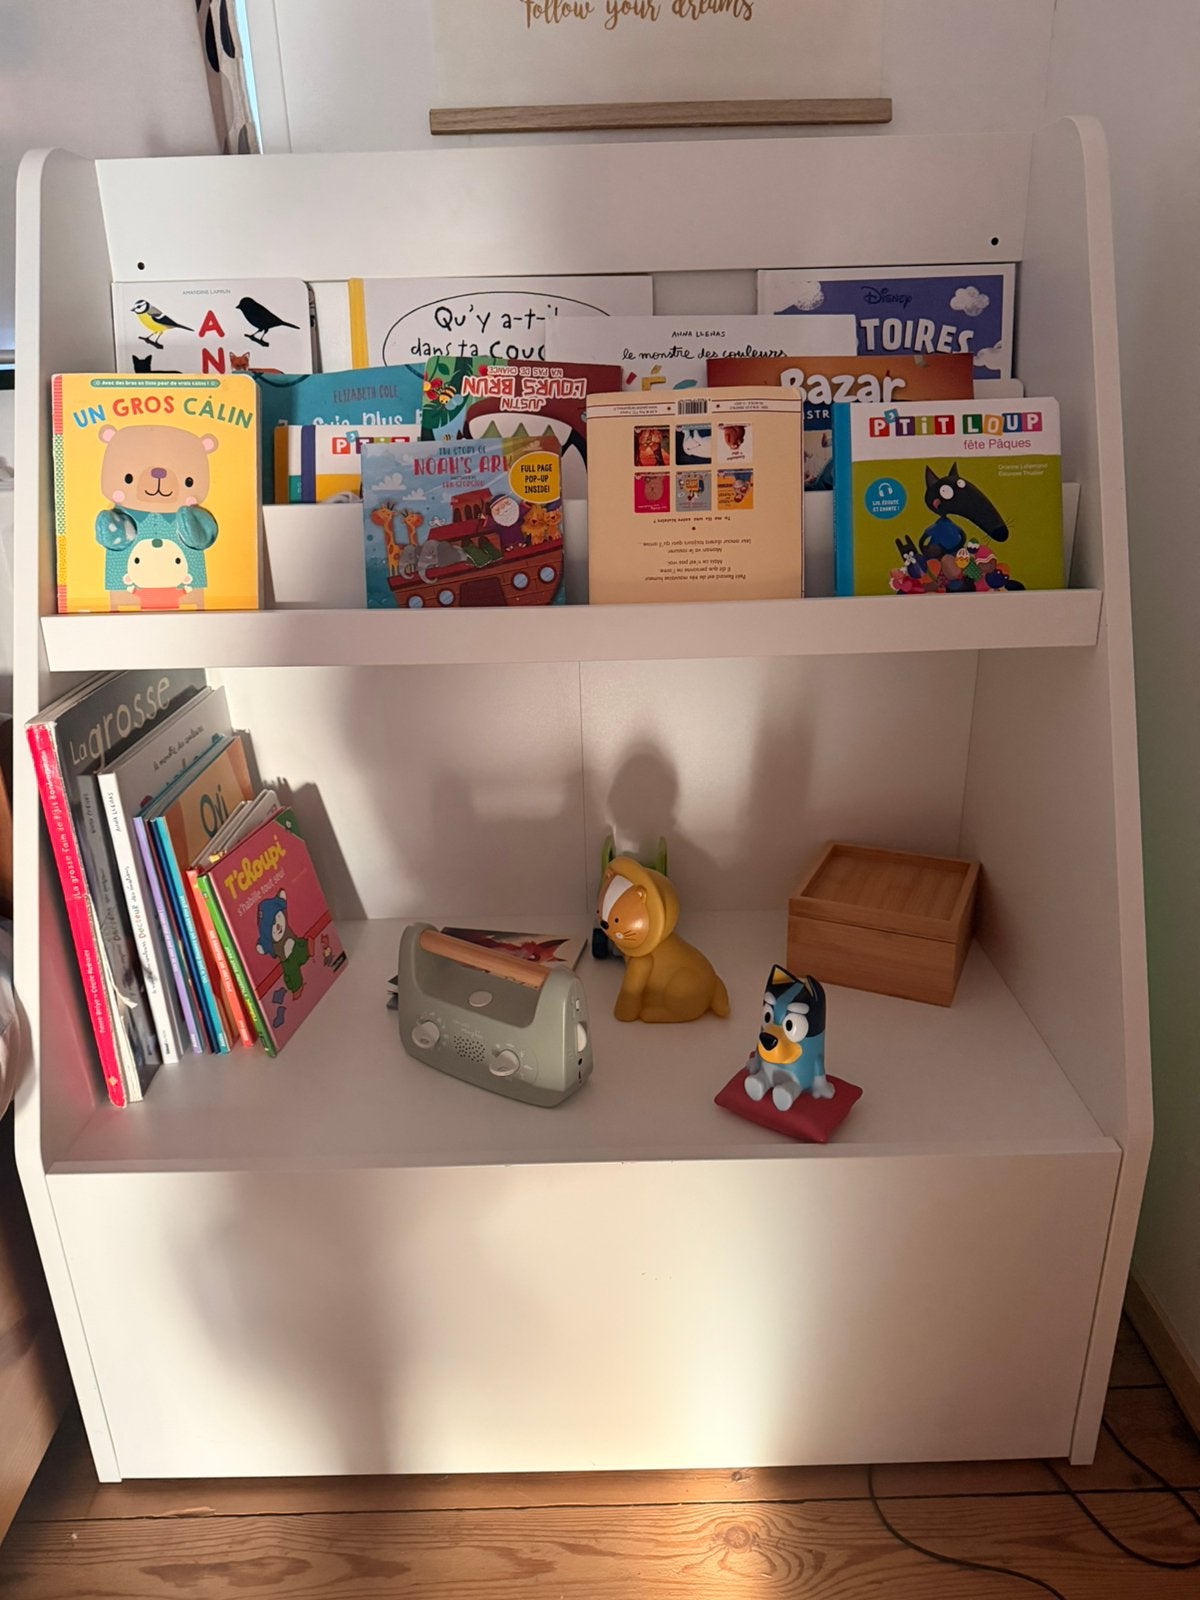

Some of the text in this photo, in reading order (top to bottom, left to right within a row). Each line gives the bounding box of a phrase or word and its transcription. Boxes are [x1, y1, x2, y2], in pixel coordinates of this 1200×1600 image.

[604, 0, 661, 31] your
[671, 0, 754, 21] dreams
[198, 310, 225, 338] A
[434, 304, 491, 334] Qu'y
[695, 330, 727, 338] LLENAS
[859, 317, 975, 354] TOIRES
[410, 337, 452, 357] dans
[458, 339, 479, 357] ta
[622, 345, 788, 360] le monstre des couleurs
[487, 365, 518, 377] CHANCE
[520, 366, 531, 376] DE
[533, 367, 549, 377] PAS
[462, 376, 587, 399] L'OURS BRUN
[780, 368, 907, 405] Bazar
[72, 403, 107, 429] UN
[111, 395, 175, 417] GROS
[499, 397, 547, 412] JUSTIN
[806, 409, 831, 420] STR
[966, 413, 1040, 434] LOUP
[963, 438, 1032, 450] fête Pâques
[413, 456, 473, 476] NOAH'S
[520, 463, 553, 473] FULL PAGE
[524, 484, 551, 494] INSIDE!
[69, 676, 171, 775] La grosse
[223, 834, 287, 900] T'choupi
